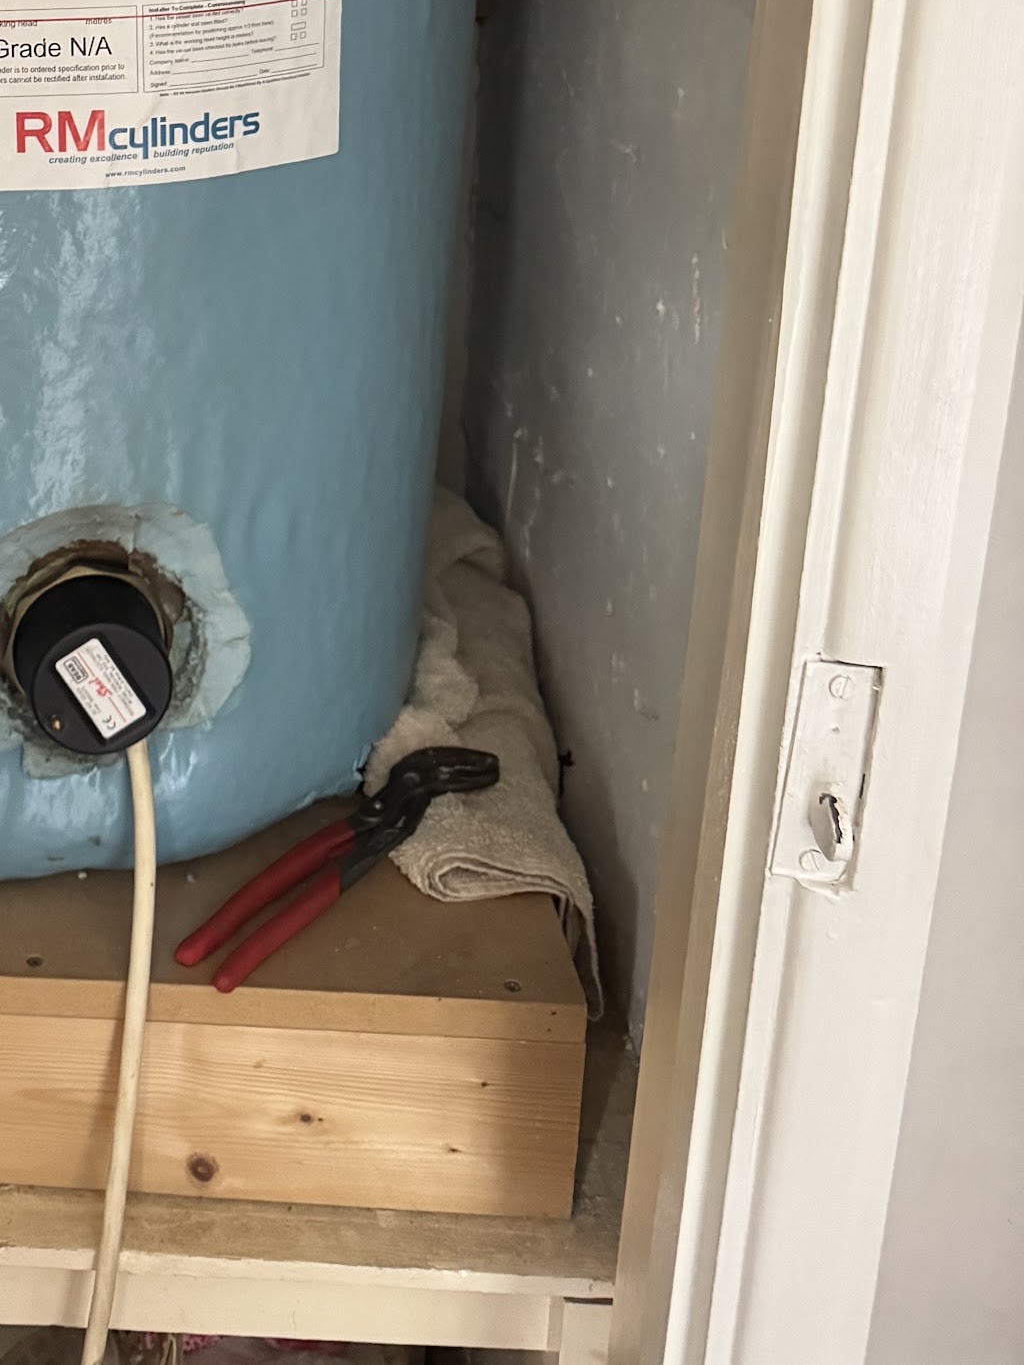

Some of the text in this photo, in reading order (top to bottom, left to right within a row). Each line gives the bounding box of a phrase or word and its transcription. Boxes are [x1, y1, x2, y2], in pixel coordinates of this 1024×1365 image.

[70, 36, 112, 56] N/A
[15, 66, 21, 74] is
[22, 66, 29, 74] to
[30, 65, 56, 73] ordered
[58, 64, 100, 74] specification
[101, 63, 117, 72] prior
[117, 63, 125, 71] to
[8, 76, 32, 84] cannot
[43, 75, 71, 83] rectified
[72, 74, 88, 82] after
[49, 142, 234, 165] creating excellence building reputation
[104, 165, 186, 178] www.rmcylinders.com
